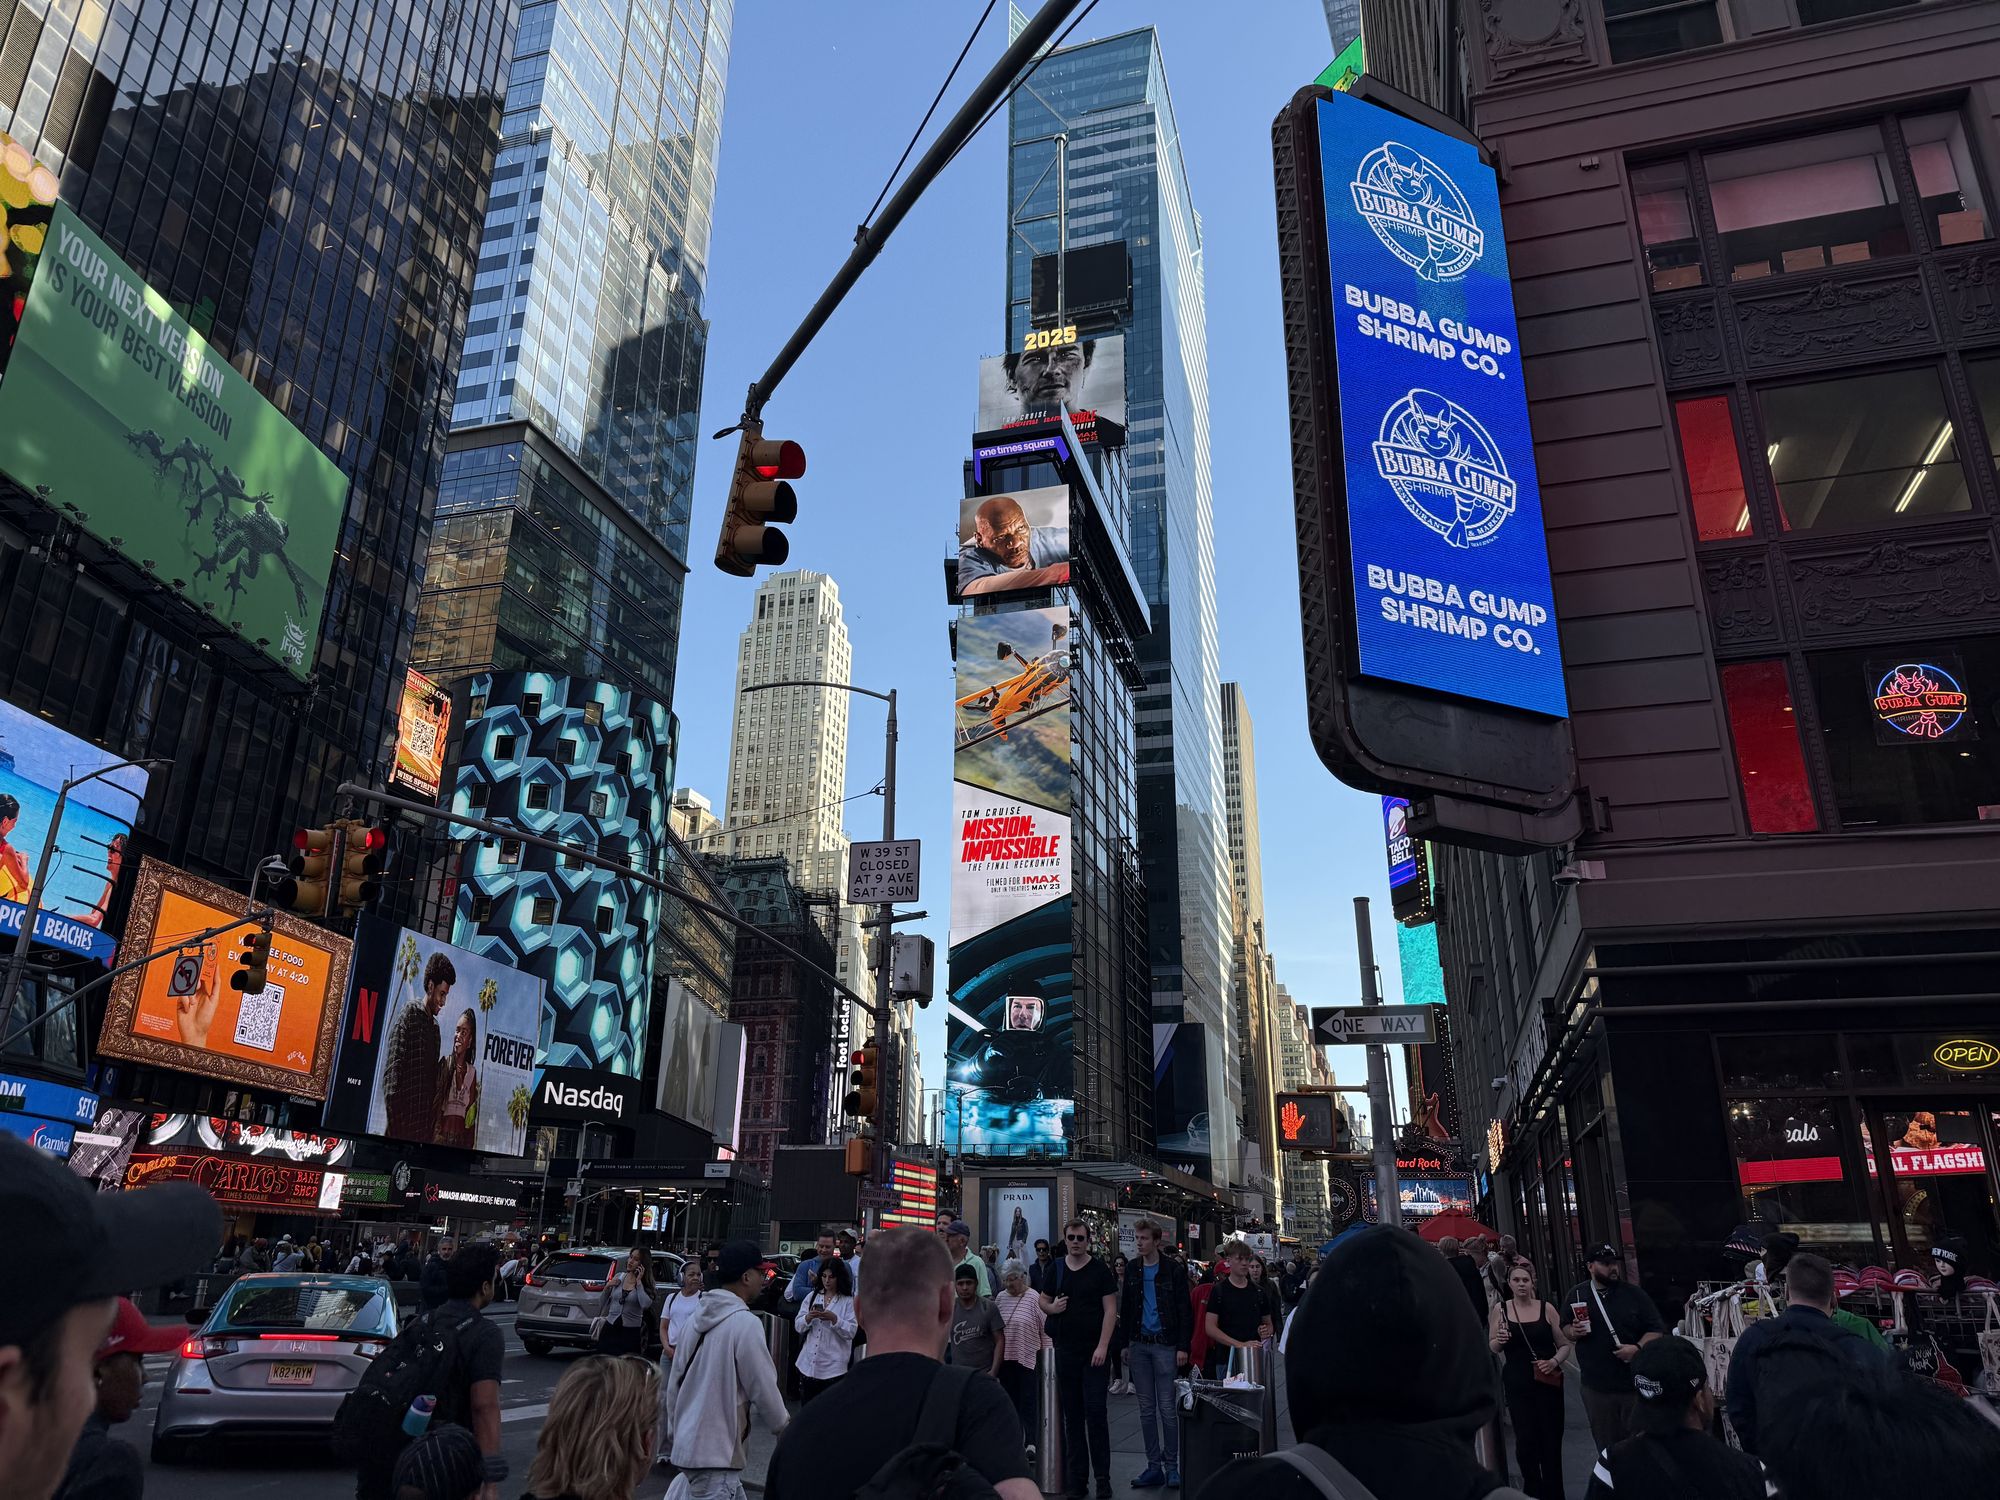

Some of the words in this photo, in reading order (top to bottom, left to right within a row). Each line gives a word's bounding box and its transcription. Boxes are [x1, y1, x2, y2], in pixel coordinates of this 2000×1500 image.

[1357, 186, 1424, 225] BUBBA
[1426, 208, 1480, 250] GUMP
[1379, 217, 1425, 238] SHRIMP
[1370, 216, 1420, 266] RESTAURANT
[1447, 252, 1472, 273] MARKET
[58, 222, 109, 292] YOUR
[110, 272, 159, 335] NEXT
[158, 318, 226, 399] VERSION
[1344, 283, 1436, 333] BUBBA
[1438, 316, 1512, 355] GUMP
[1024, 325, 1077, 351] 2025
[1357, 314, 1456, 361] SHRIMP
[1461, 349, 1506, 380] CO.
[46, 257, 68, 294] IS
[72, 280, 120, 341] YOUR
[121, 325, 167, 380] BEST
[167, 368, 233, 441] VERSION
[979, 445, 997, 457] one
[997, 442, 1022, 455] times
[1023, 438, 1055, 452] square
[1380, 446, 1452, 483] BUBBA
[1454, 463, 1512, 503] GUMP
[1404, 480, 1453, 498] SHRIMP
[1392, 478, 1447, 532] RESTAURANT
[1477, 509, 1503, 535] MARKET
[1367, 563, 1464, 610] BUBBA
[1469, 589, 1547, 627] GUMP
[1380, 597, 1488, 641] SHRIMP
[1493, 623, 1541, 655] CO.
[280, 635, 304, 665] JFrog
[1878, 696, 1923, 710] BUBBA
[1925, 694, 1963, 707] GUMP
[397, 769, 413, 782] WISE
[413, 778, 437, 794] SPIRITS
[962, 809, 980, 818] TOM
[985, 806, 1021, 817] CRUISE
[962, 815, 1036, 841] MISSION:
[860, 848, 871, 858] W
[874, 847, 890, 857] 39
[895, 846, 909, 857] ST
[961, 835, 1060, 863] IMPOSSIBLE
[1388, 836, 1411, 856] TACO
[859, 859, 909, 871] CLOSED
[968, 863, 982, 872] THE
[986, 861, 1009, 871] FINAL
[1014, 858, 1060, 869] RECKONING
[1391, 849, 1413, 866] BELL
[854, 874, 871, 885] AT
[875, 874, 882, 883] 9
[887, 873, 914, 883] AVE
[986, 877, 1008, 886] FILMED
[1008, 876, 1021, 885] FOR
[1022, 874, 1060, 885] IMAX
[0, 904, 40, 934] PICL
[44, 917, 95, 951] BEACHES
[281, 951, 304, 967] FOOD
[277, 966, 288, 978] AT
[289, 971, 310, 985] 4:20
[839, 998, 850, 1039] Locker
[1331, 1018, 1365, 1033] ONE
[1381, 1016, 1417, 1032] WAY
[483, 1033, 535, 1072] FOREVER
[836, 1041, 848, 1068] Foot
[1938, 1046, 1993, 1063] OPEN
[347, 1077, 358, 1085] MAY
[76, 1096, 92, 1117] SET
[543, 1080, 624, 1119] Nasdaq
[239, 1123, 265, 1146] Fresh
[127, 1155, 178, 1183] CARLO'S
[1417, 1157, 1441, 1171] Rock
[1911, 1150, 1985, 1170] FLAGSHI
[188, 1155, 291, 1195] CARLO'S
[296, 1171, 322, 1185] BAKE
[343, 1177, 389, 1188] RBUCKS
[293, 1184, 319, 1198] SHOP
[342, 1188, 375, 1196] OFFEE
[479, 1194, 493, 1204] STORE
[493, 1196, 503, 1206] NEW
[503, 1198, 517, 1207] YORK
